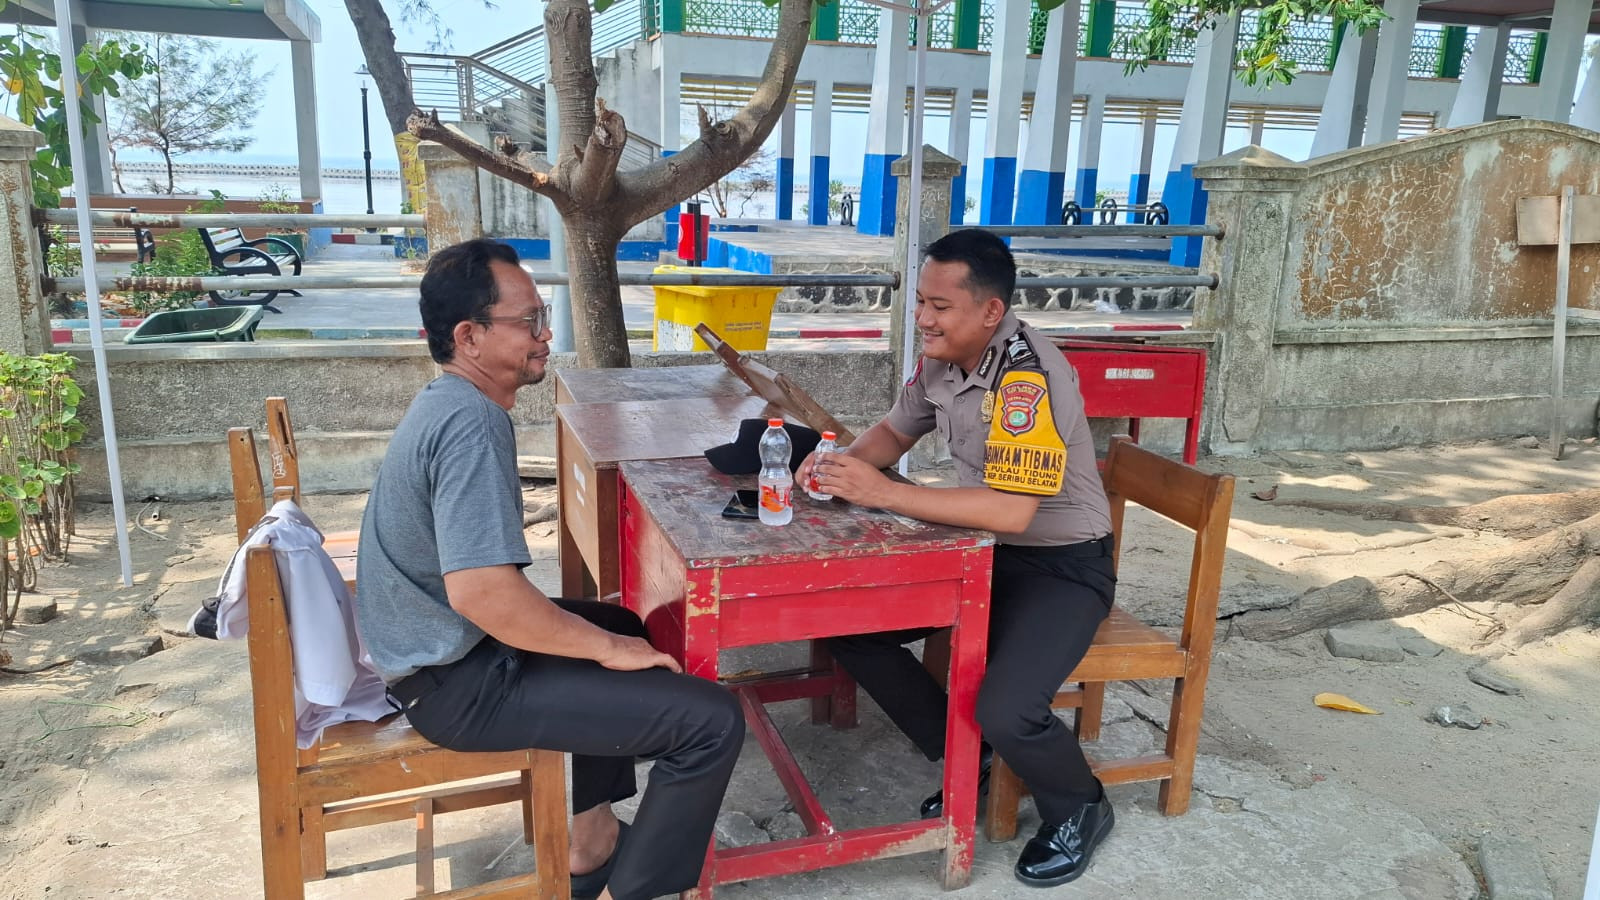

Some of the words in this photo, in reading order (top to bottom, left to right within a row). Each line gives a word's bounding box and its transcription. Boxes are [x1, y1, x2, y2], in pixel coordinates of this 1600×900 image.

[991, 465, 1020, 475] PULAU
[1024, 469, 1058, 480] TIDUNG
[999, 473, 1026, 484] SERIBU
[1027, 479, 1057, 489] SELATAN
